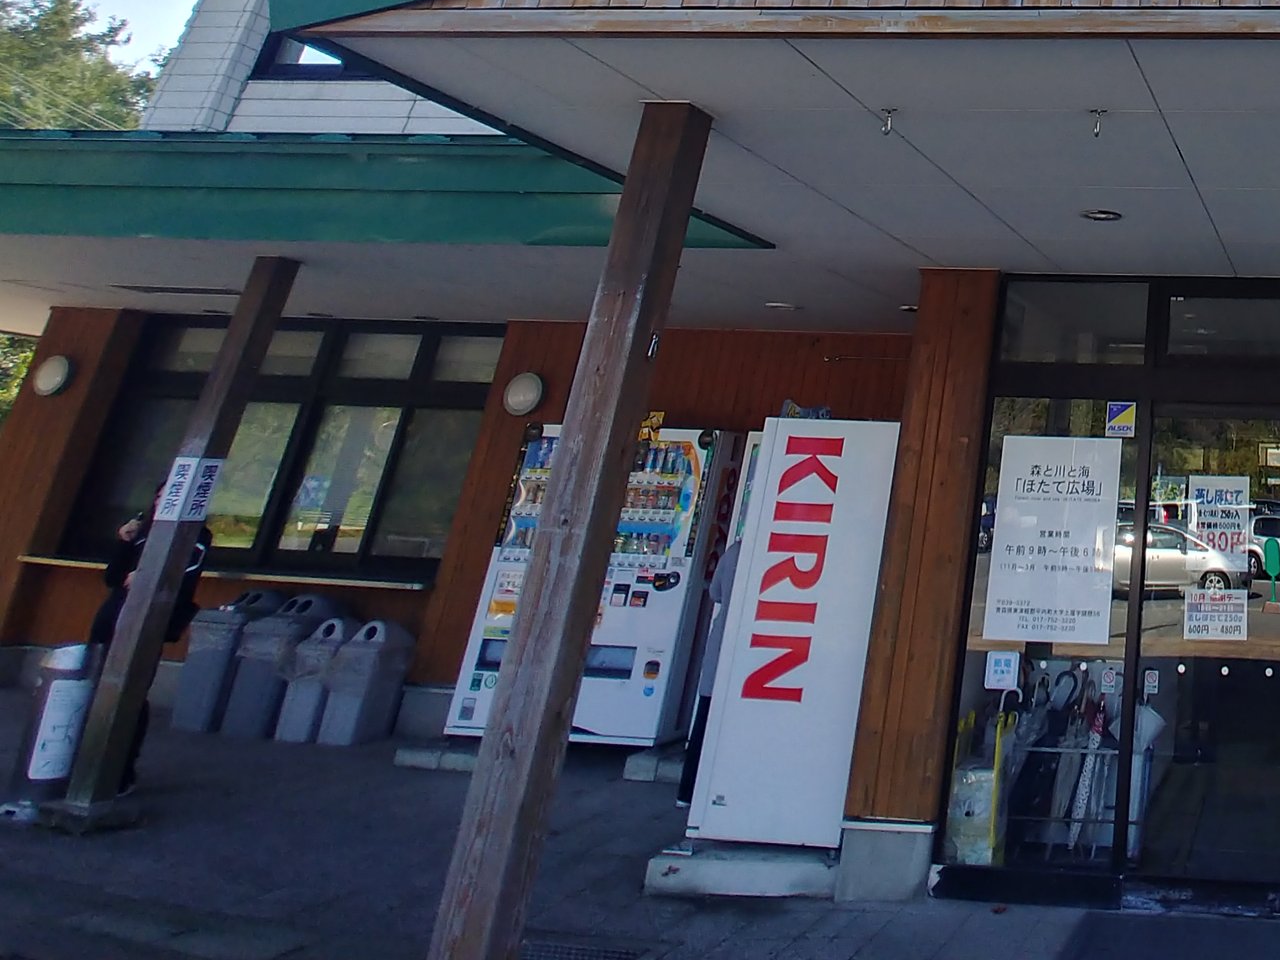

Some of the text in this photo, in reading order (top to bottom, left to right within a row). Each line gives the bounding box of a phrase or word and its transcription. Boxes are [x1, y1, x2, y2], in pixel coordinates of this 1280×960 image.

[1030, 464, 1091, 479] 森と川と海
[1015, 478, 1103, 496] 「ほたて広場」
[1039, 530, 1070, 539] 営業時間
[741, 435, 846, 703] KIRIN
